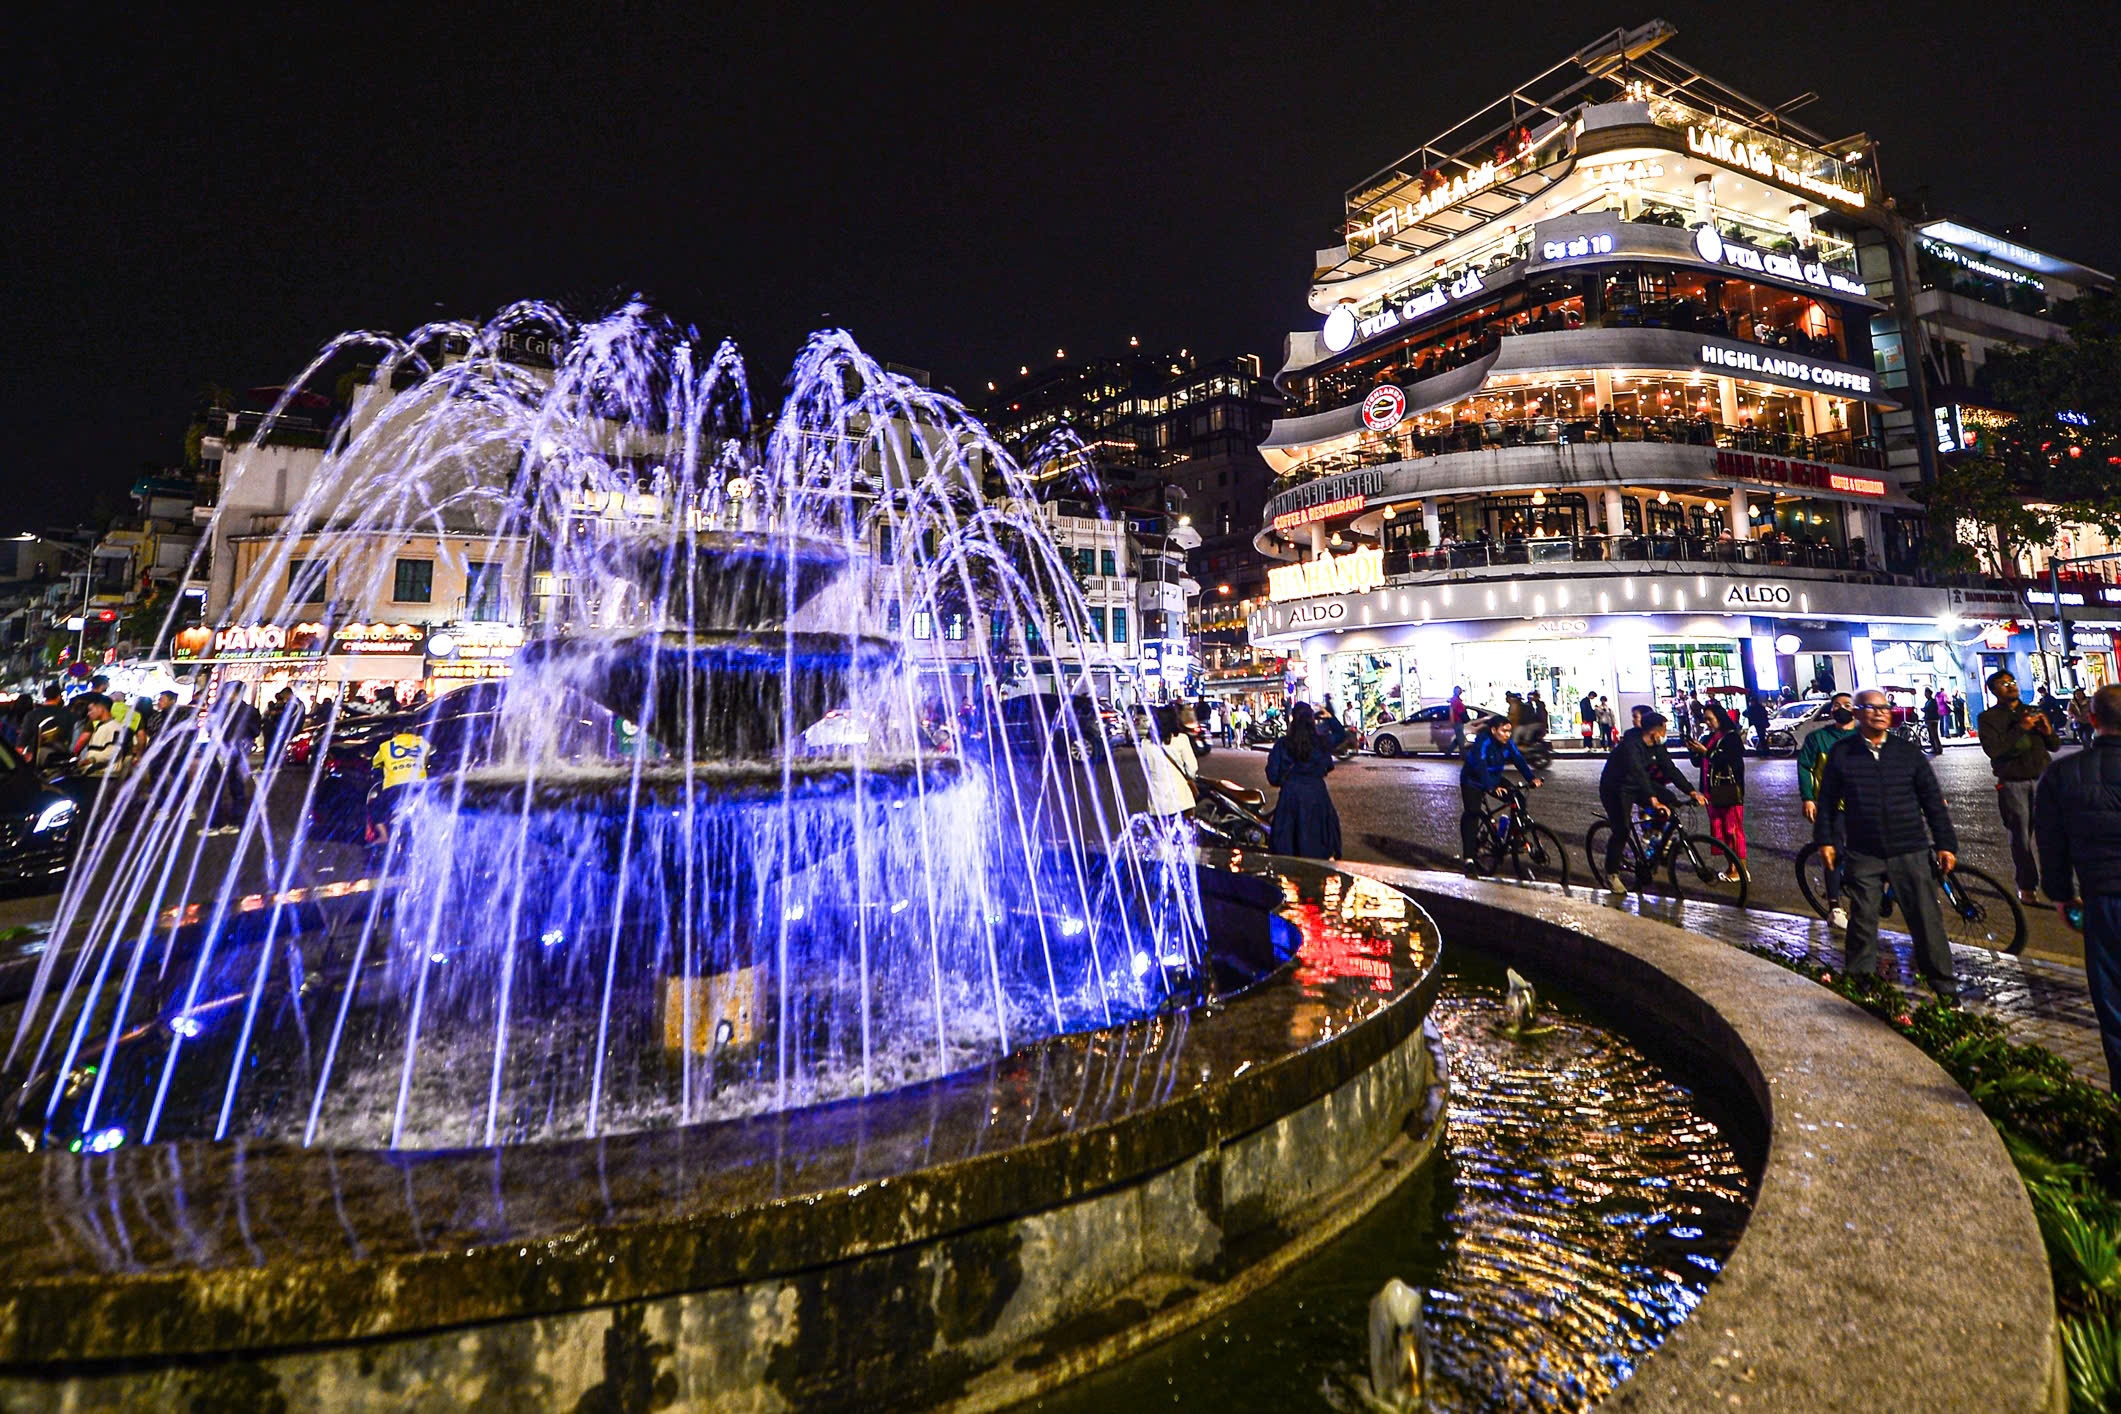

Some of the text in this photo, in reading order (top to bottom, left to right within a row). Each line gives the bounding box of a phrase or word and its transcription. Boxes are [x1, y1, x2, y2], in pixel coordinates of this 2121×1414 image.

[1687, 125, 1749, 170] LAIKA
[1405, 181, 1468, 225] LAIKA
[1722, 243, 1765, 272] VUA
[1358, 308, 1400, 339] VUA
[1701, 345, 1871, 393] HIGHLANDS COFFEE
[1365, 387, 1402, 412] HIGHLANDS
[1370, 413, 1401, 429] COFFEE
[1273, 511, 1301, 529] COFFEE
[1307, 494, 1366, 520] RESTAURANT
[1728, 586, 1791, 603] ALDO
[1288, 603, 1344, 626] ALDO
[1537, 621, 1588, 634] ALDO
